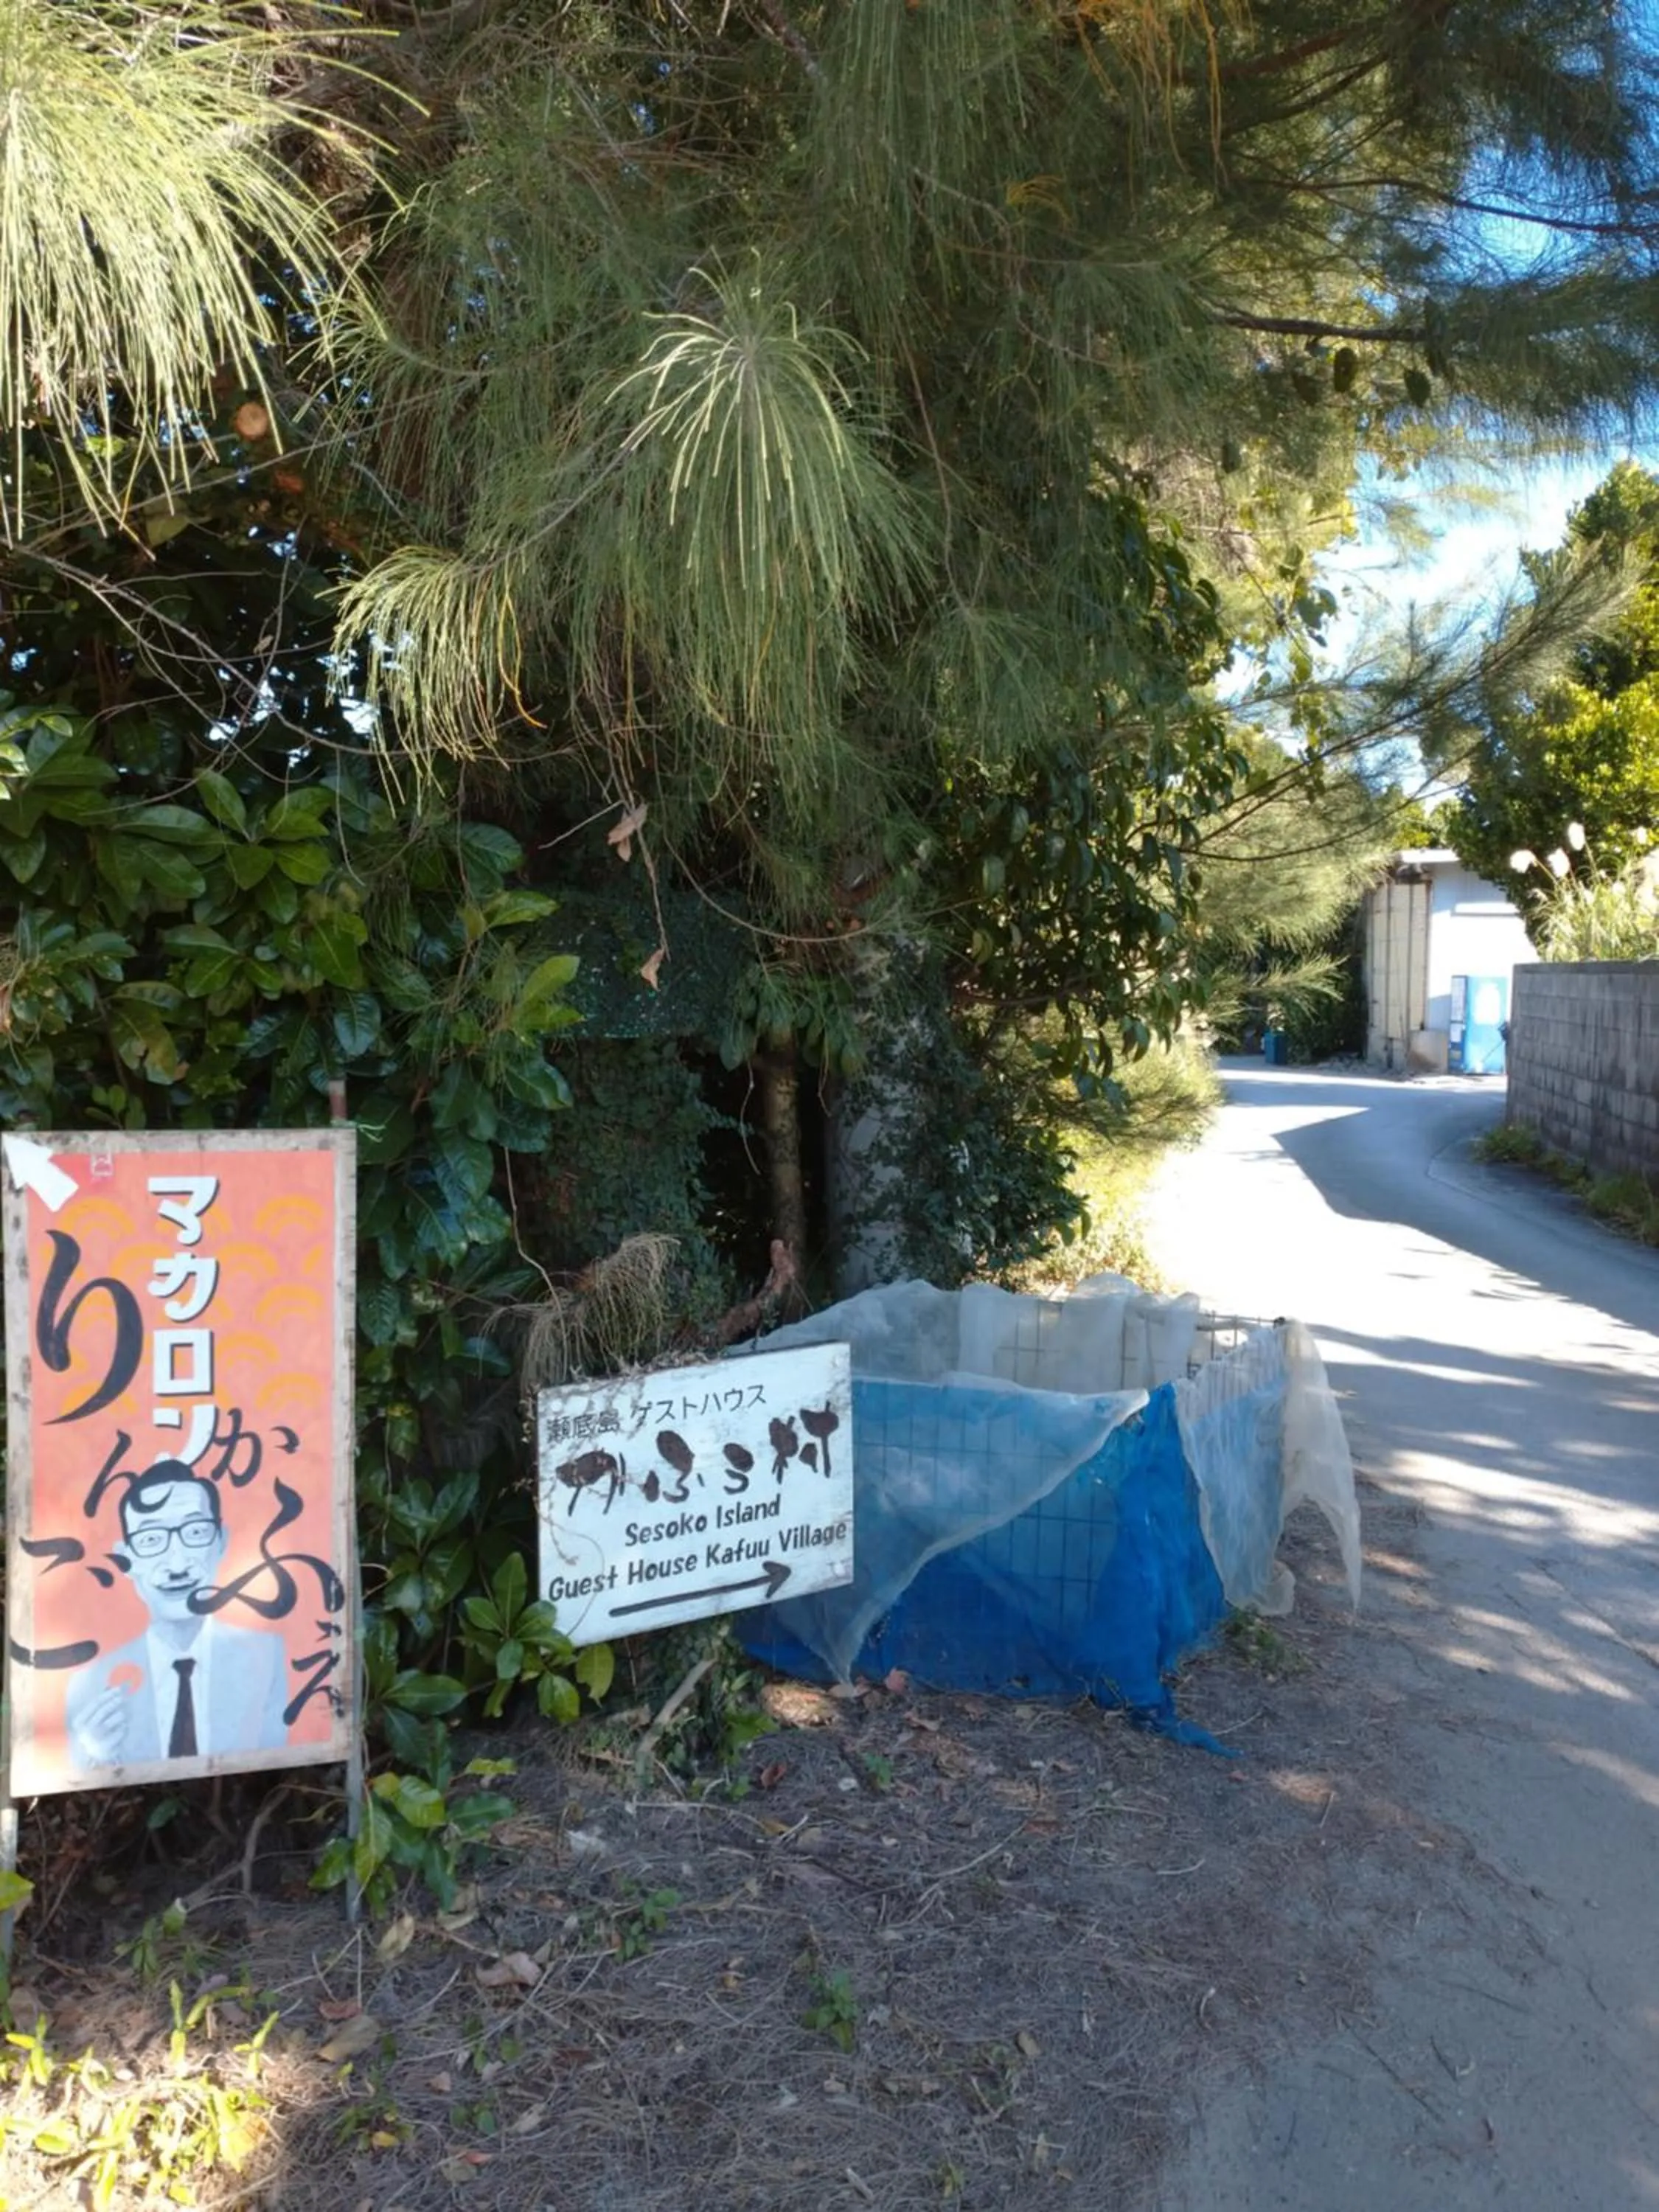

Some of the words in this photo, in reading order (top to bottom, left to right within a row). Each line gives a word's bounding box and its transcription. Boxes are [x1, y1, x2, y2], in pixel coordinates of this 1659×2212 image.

[147, 1176, 219, 1466] マカロン
[546, 1411, 621, 1443] 瀬底島
[630, 1385, 767, 1426] ゲストハウス
[625, 1511, 708, 1548] Sesoko
[716, 1494, 781, 1530] Island
[548, 1564, 619, 1602] Guest
[627, 1553, 698, 1586] House
[706, 1537, 771, 1568] Kafuu
[779, 1521, 847, 1554] Village
